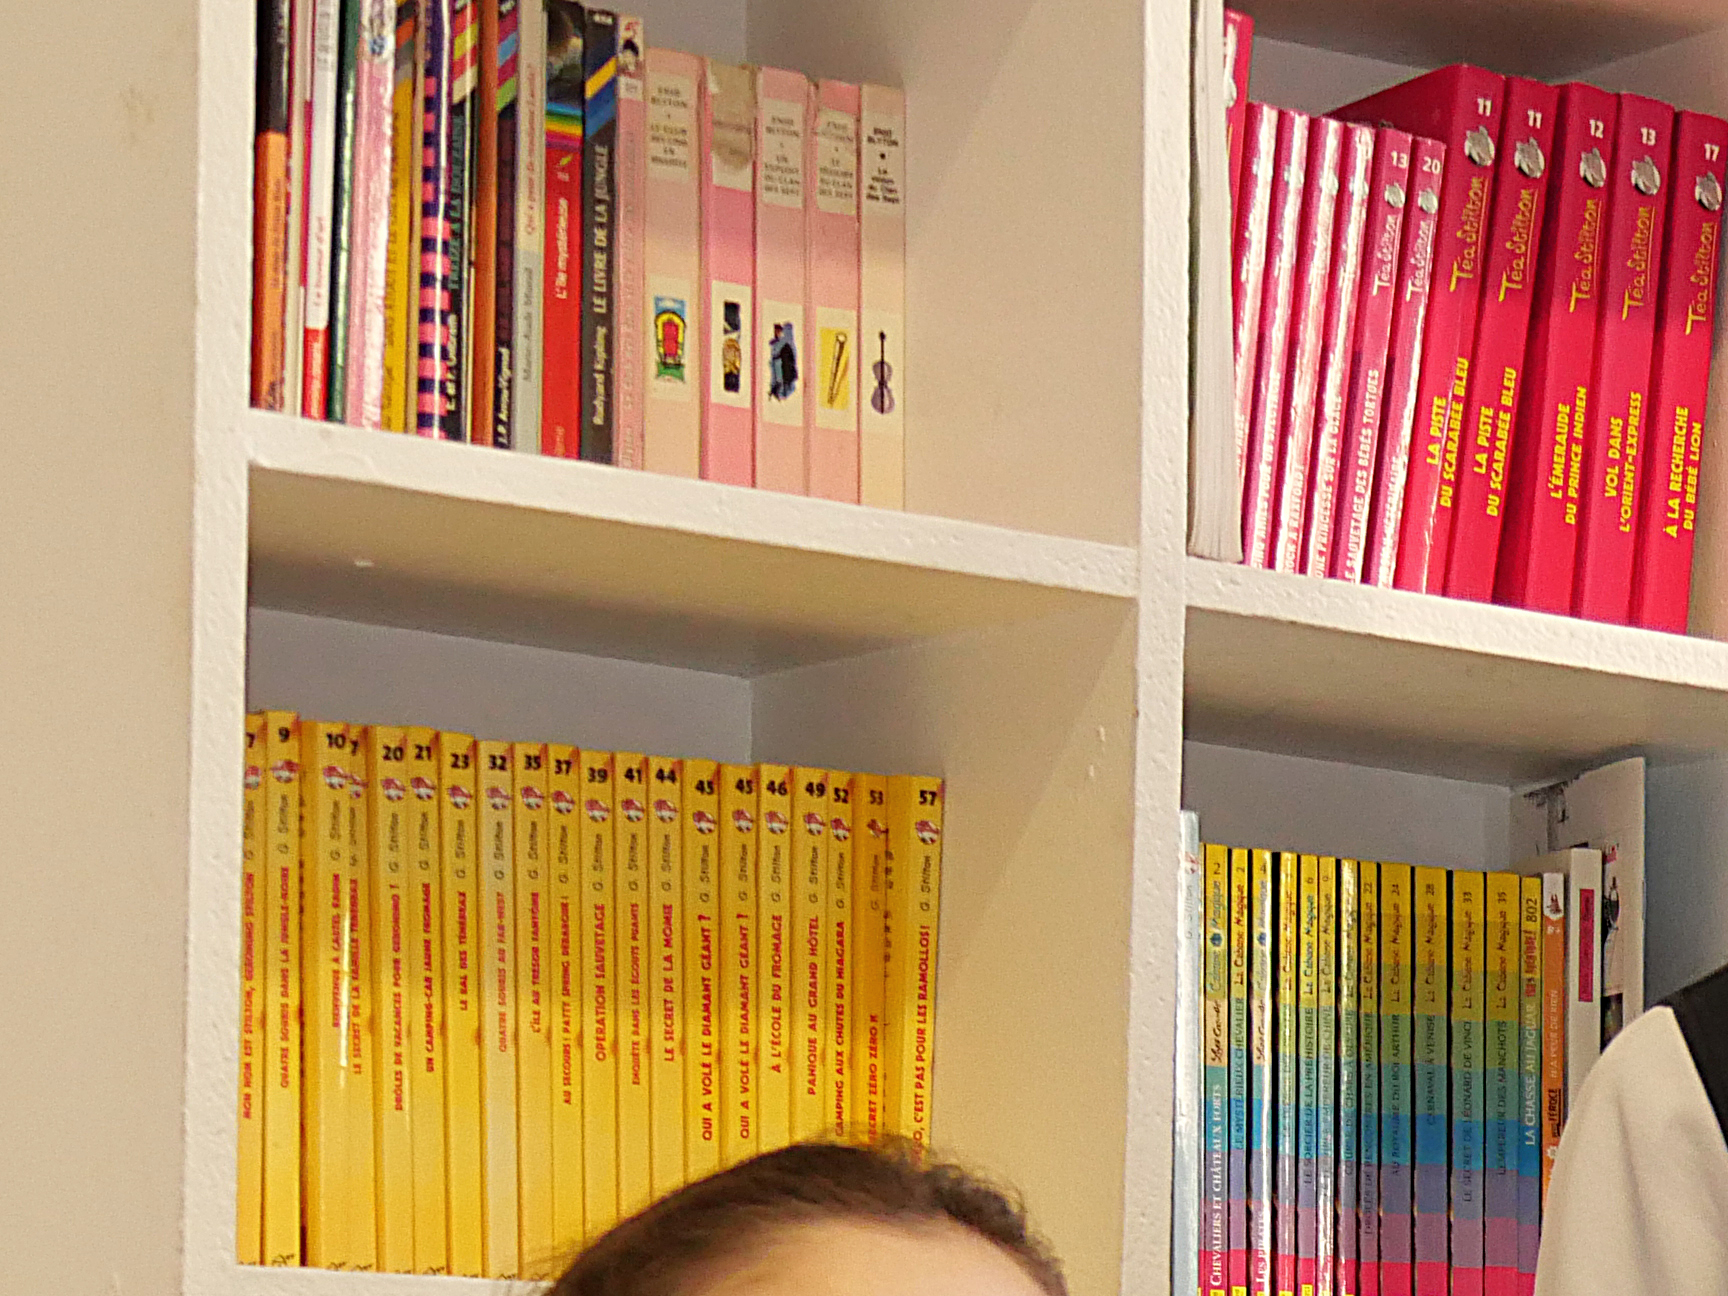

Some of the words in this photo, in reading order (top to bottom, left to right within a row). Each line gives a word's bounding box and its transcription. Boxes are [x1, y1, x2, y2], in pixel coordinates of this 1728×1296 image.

[1478, 98, 1491, 116] 11
[1528, 110, 1541, 128] 11
[1590, 120, 1603, 138] 12
[1641, 128, 1656, 146] 13
[1392, 152, 1407, 168] 13
[1705, 144, 1719, 162] 17
[1423, 157, 1440, 174] 20
[1455, 175, 1487, 243] Stilton
[1504, 187, 1536, 254] Stilton
[1572, 197, 1600, 263] Stilton
[1626, 205, 1653, 271] Stilton
[1689, 220, 1715, 286] Stilton
[1500, 367, 1516, 406] BLEU
[1428, 395, 1447, 437] PISTE
[1572, 385, 1587, 438] INDIEN
[1439, 485, 1453, 508] DU
[1452, 357, 1469, 396] BLEU
[1476, 406, 1493, 446] PISTE
[1607, 416, 1623, 458] DANS
[1488, 410, 1510, 490] SCARABÉE
[1669, 405, 1688, 491] RECHERCHE
[1689, 422, 1702, 460] LION
[1425, 442, 1441, 465] LA
[1472, 452, 1487, 474] LA
[1618, 391, 1642, 532] L'ORIENT-EXPRESS
[1567, 443, 1581, 497] PRINCE
[1604, 464, 1619, 497] VOL
[1683, 466, 1697, 503] BÉBÉ
[1486, 494, 1500, 516] DU
[1565, 503, 1576, 524] DU
[1667, 497, 1680, 518] LA
[1683, 509, 1694, 530] DU
[278, 727, 290, 742] 9
[383, 745, 404, 761] 20
[414, 744, 432, 760] 21
[488, 755, 507, 770] 32
[588, 767, 607, 782] 39
[655, 769, 676, 783] 44
[696, 780, 714, 794] 45
[736, 779, 753, 794] 45
[805, 782, 826, 796] 49
[919, 790, 936, 804] 57
[1525, 1004, 1536, 1050] JAGUAR
[1524, 1053, 1535, 1072] AU
[1524, 1075, 1535, 1125] CHASSE
[1524, 1129, 1535, 1144] LA
